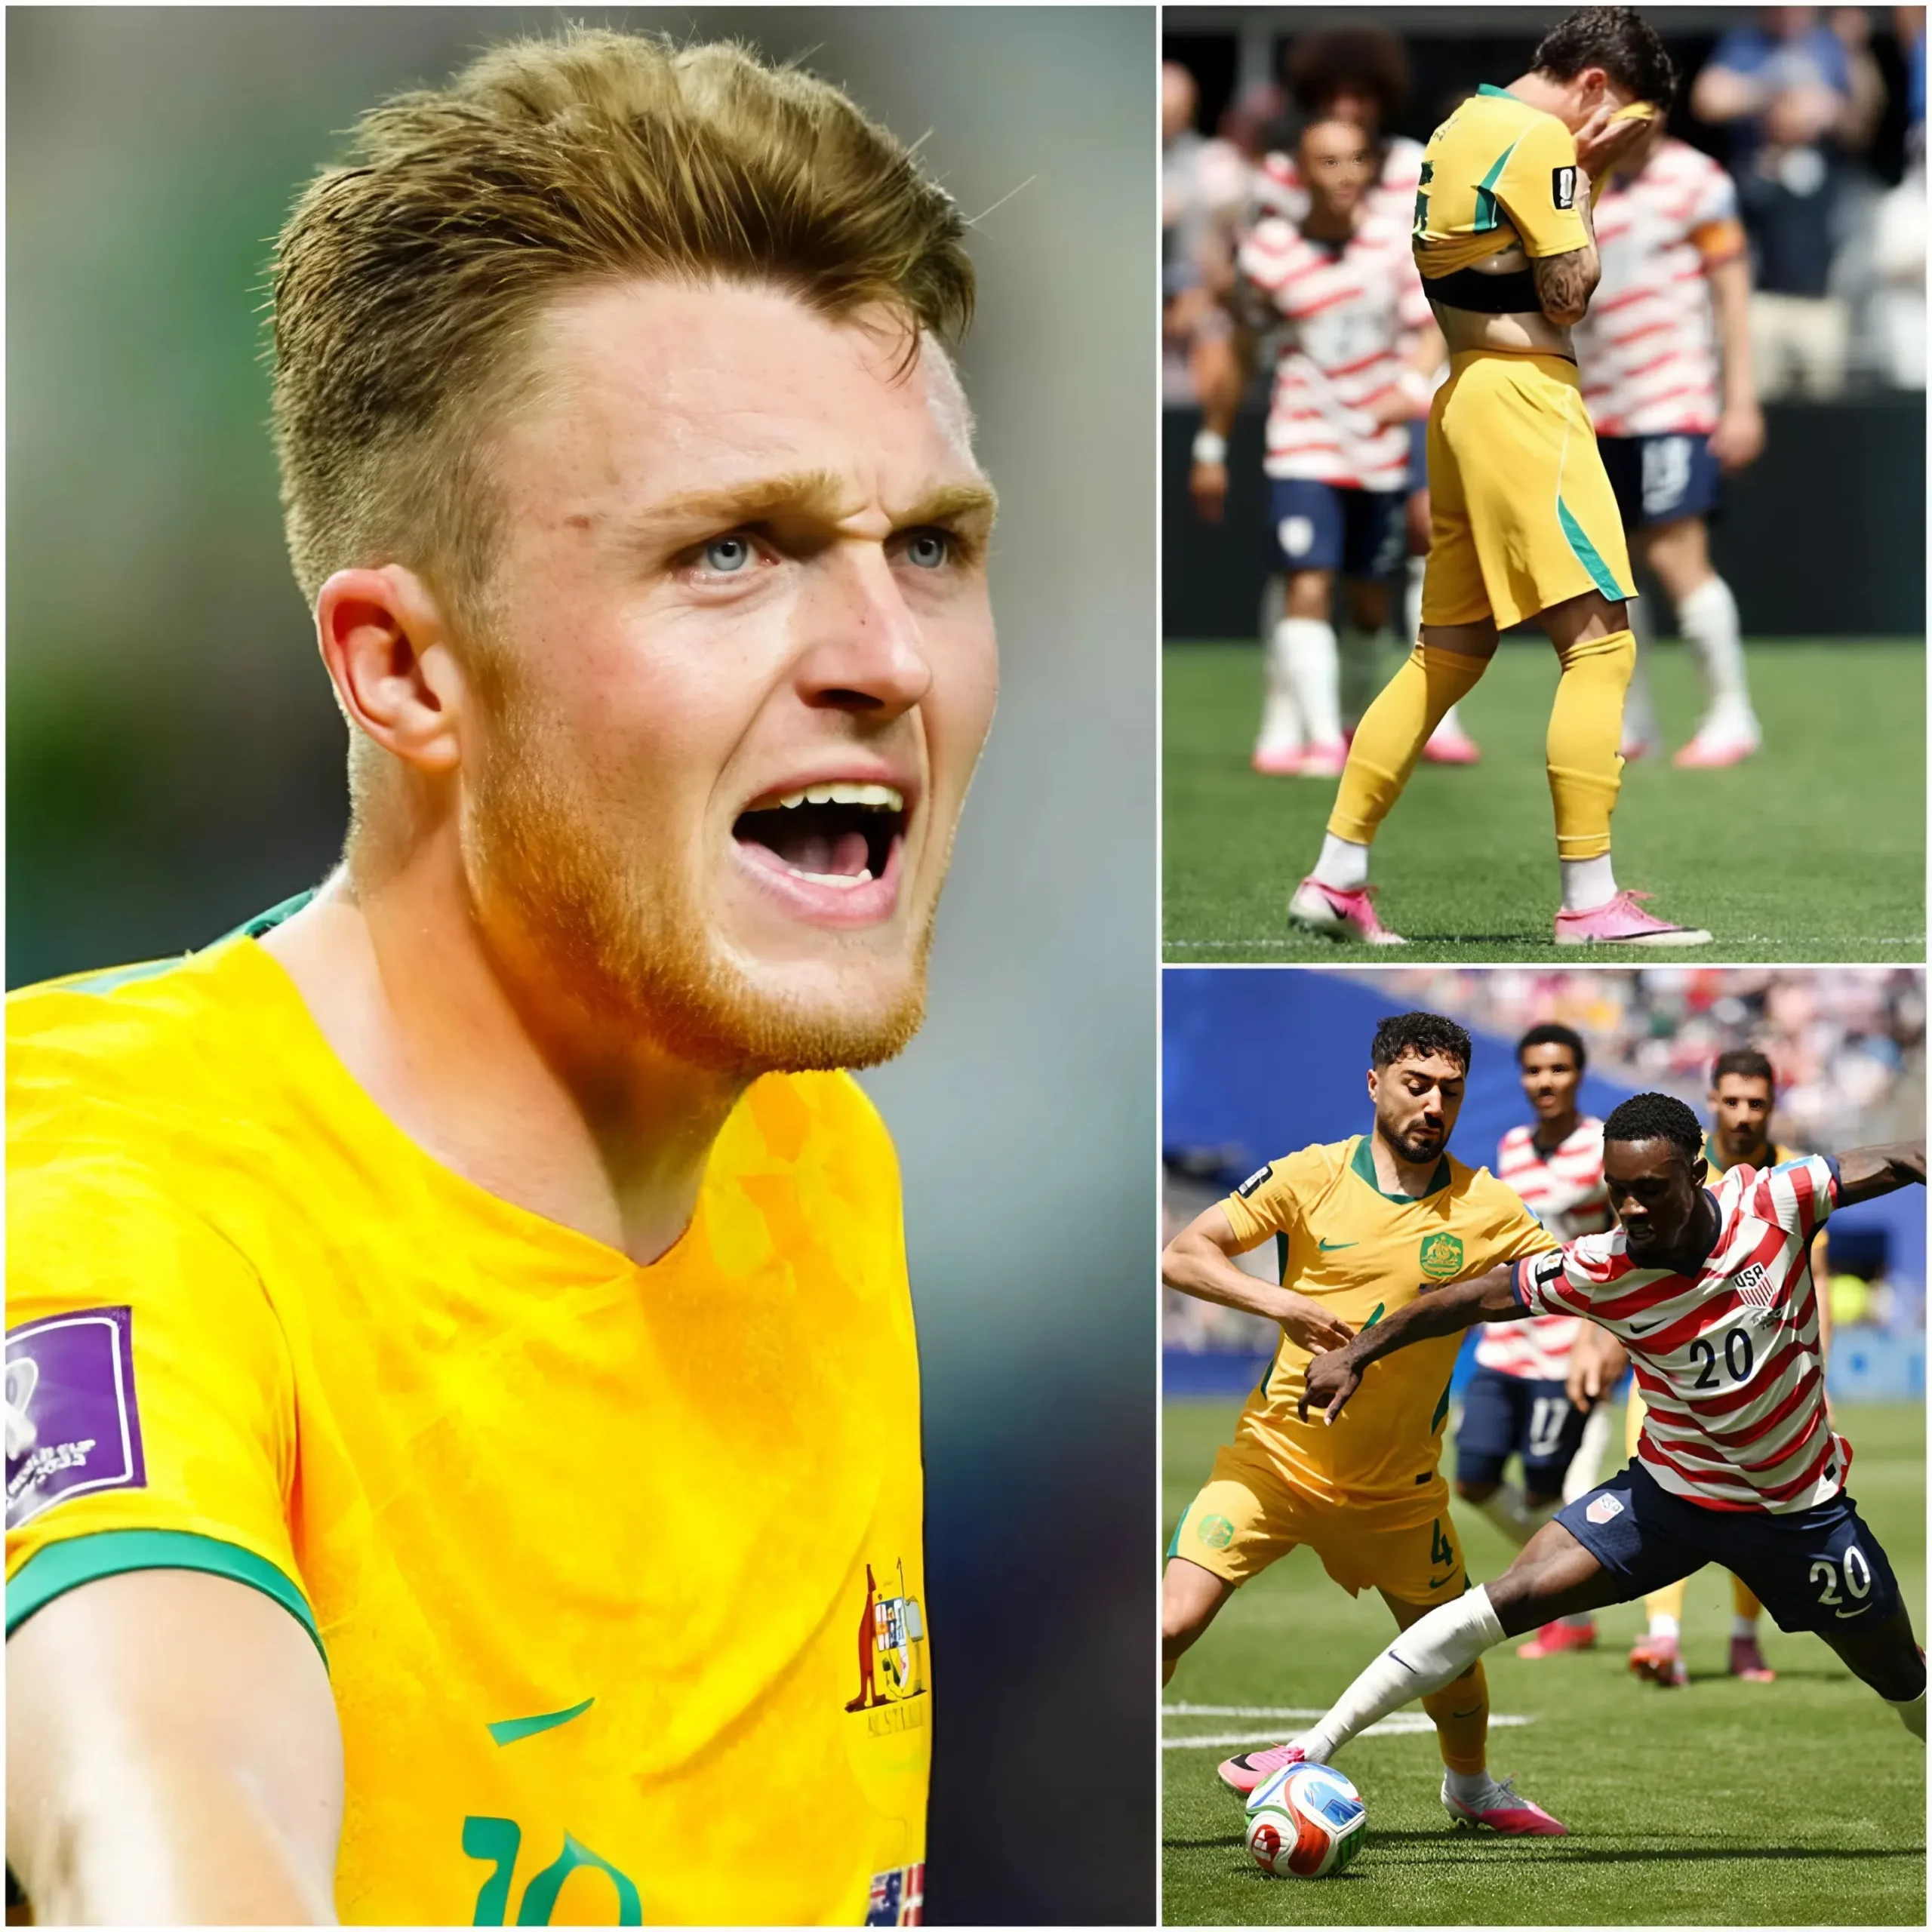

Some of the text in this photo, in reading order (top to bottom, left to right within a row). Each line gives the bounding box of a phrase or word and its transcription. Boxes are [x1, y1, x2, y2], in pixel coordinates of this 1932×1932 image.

[1734, 1264, 1764, 1287] USA
[1690, 1327, 1754, 1389] 20
[1530, 1397, 1570, 1444] 17
[1431, 1518, 1454, 1567] 4
[1810, 1545, 1872, 1605] 20
